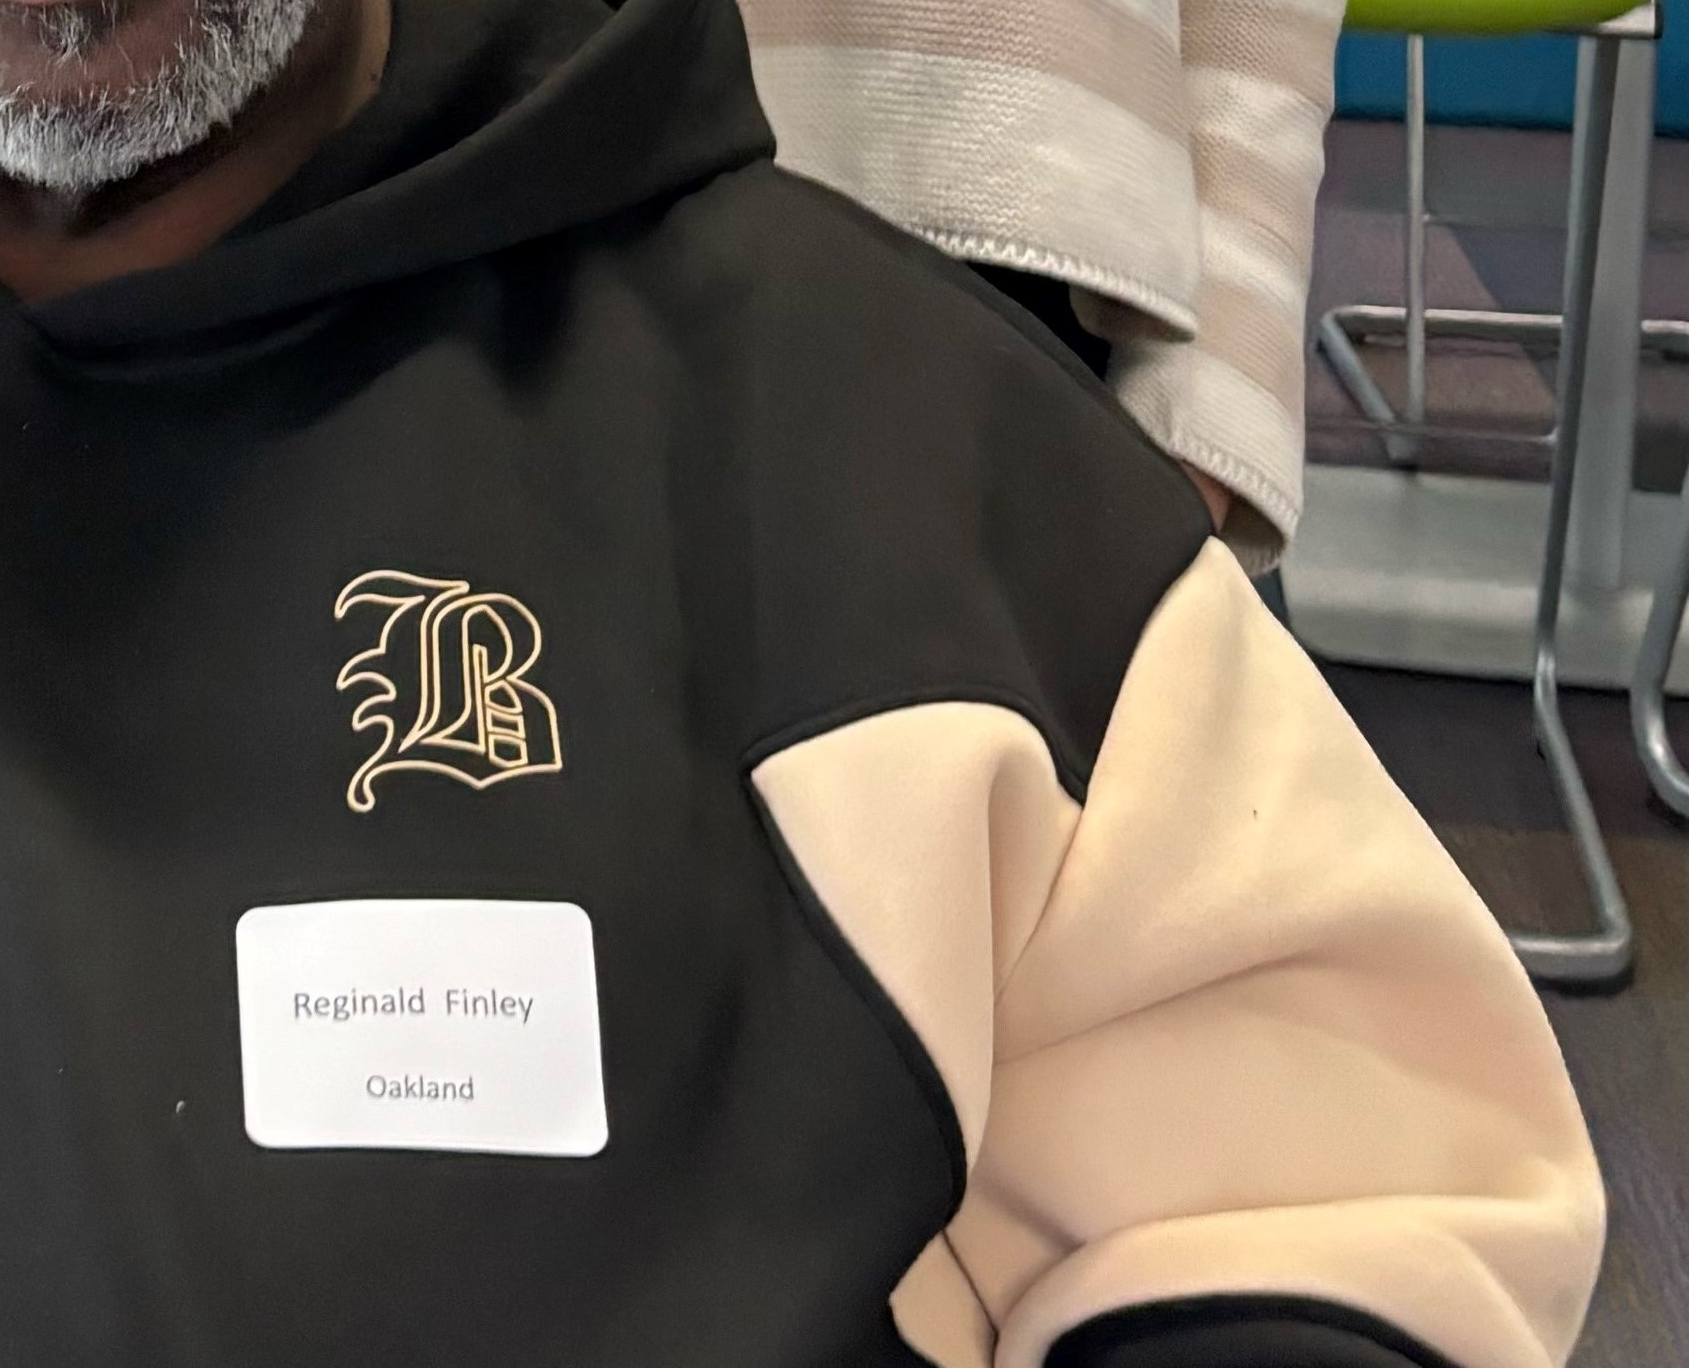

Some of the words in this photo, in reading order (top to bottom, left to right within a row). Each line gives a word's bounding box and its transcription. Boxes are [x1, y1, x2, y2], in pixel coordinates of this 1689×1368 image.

[293, 986, 426, 1023] Reginald
[445, 987, 534, 1025] Finley
[366, 1073, 475, 1102] Oakland
